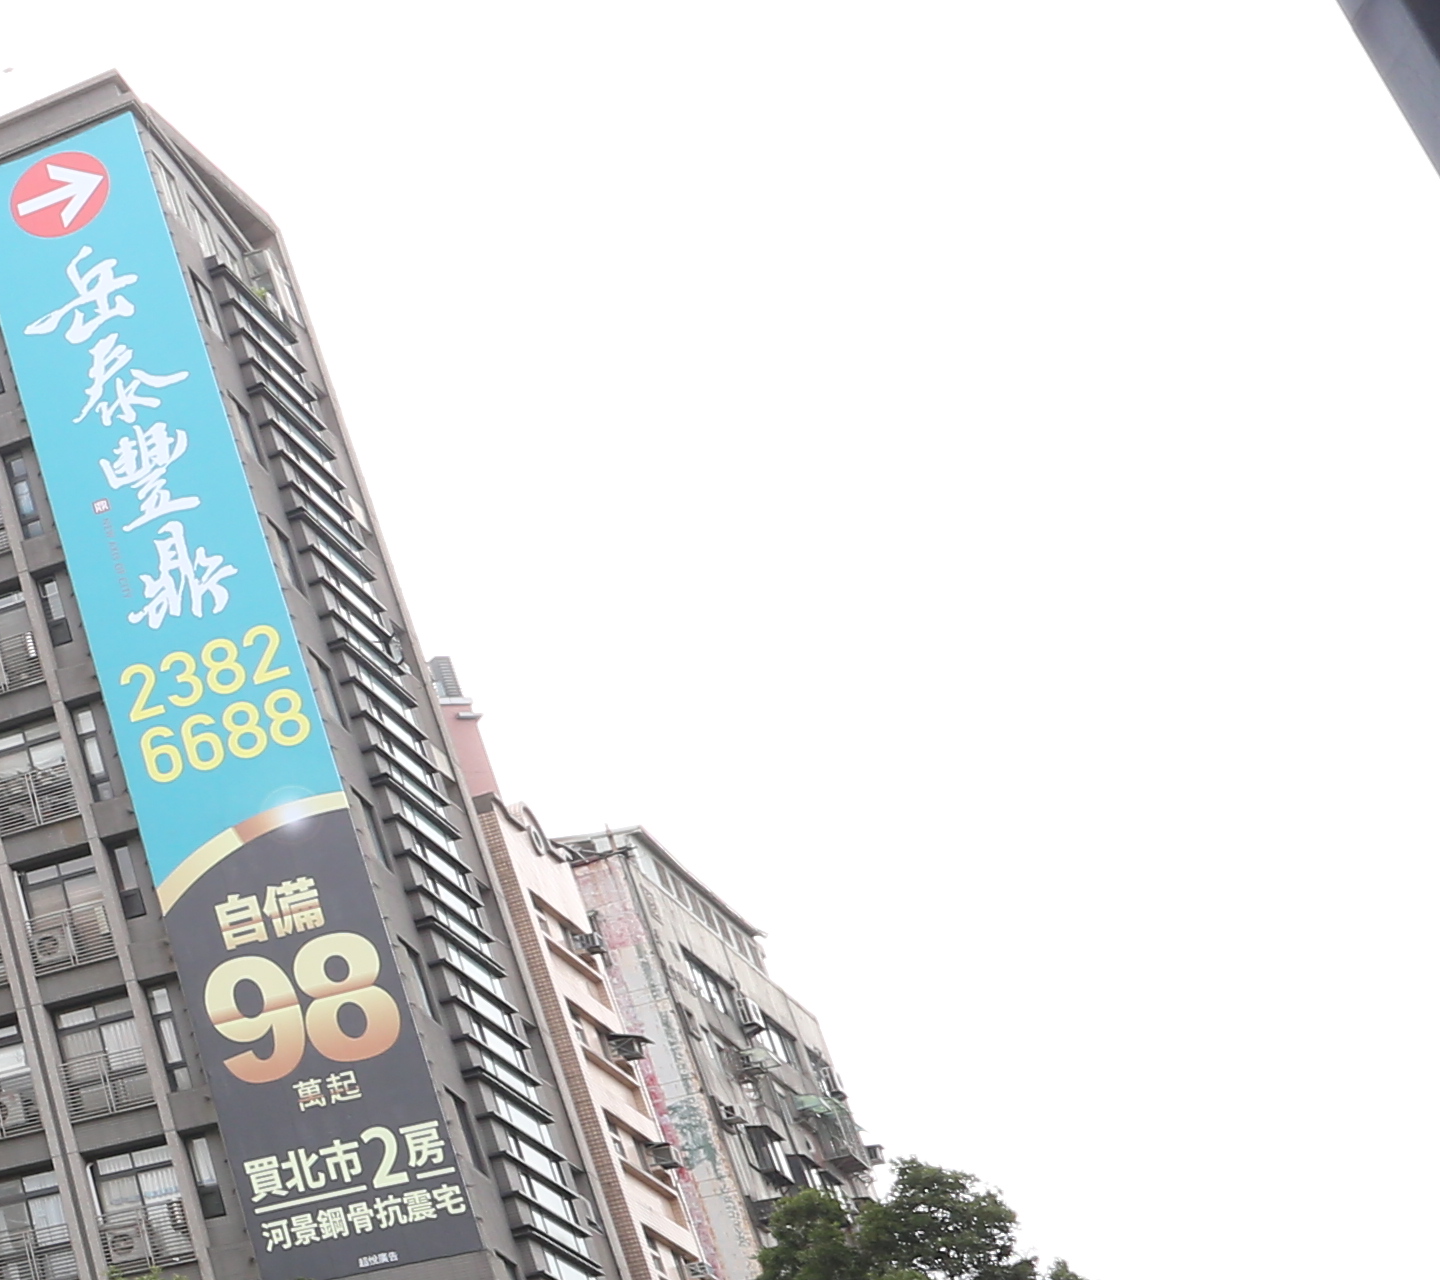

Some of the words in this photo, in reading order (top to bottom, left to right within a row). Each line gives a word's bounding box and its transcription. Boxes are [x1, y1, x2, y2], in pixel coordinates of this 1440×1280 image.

[24, 246, 237, 628] 岳泰豐鼎
[120, 625, 290, 722] 2382
[140, 688, 311, 783] 6688
[214, 877, 326, 950] 自備
[204, 931, 401, 1084] 98
[292, 1070, 362, 1111] 萬起
[261, 1184, 467, 1252] 河景鋼骨抗震宅
